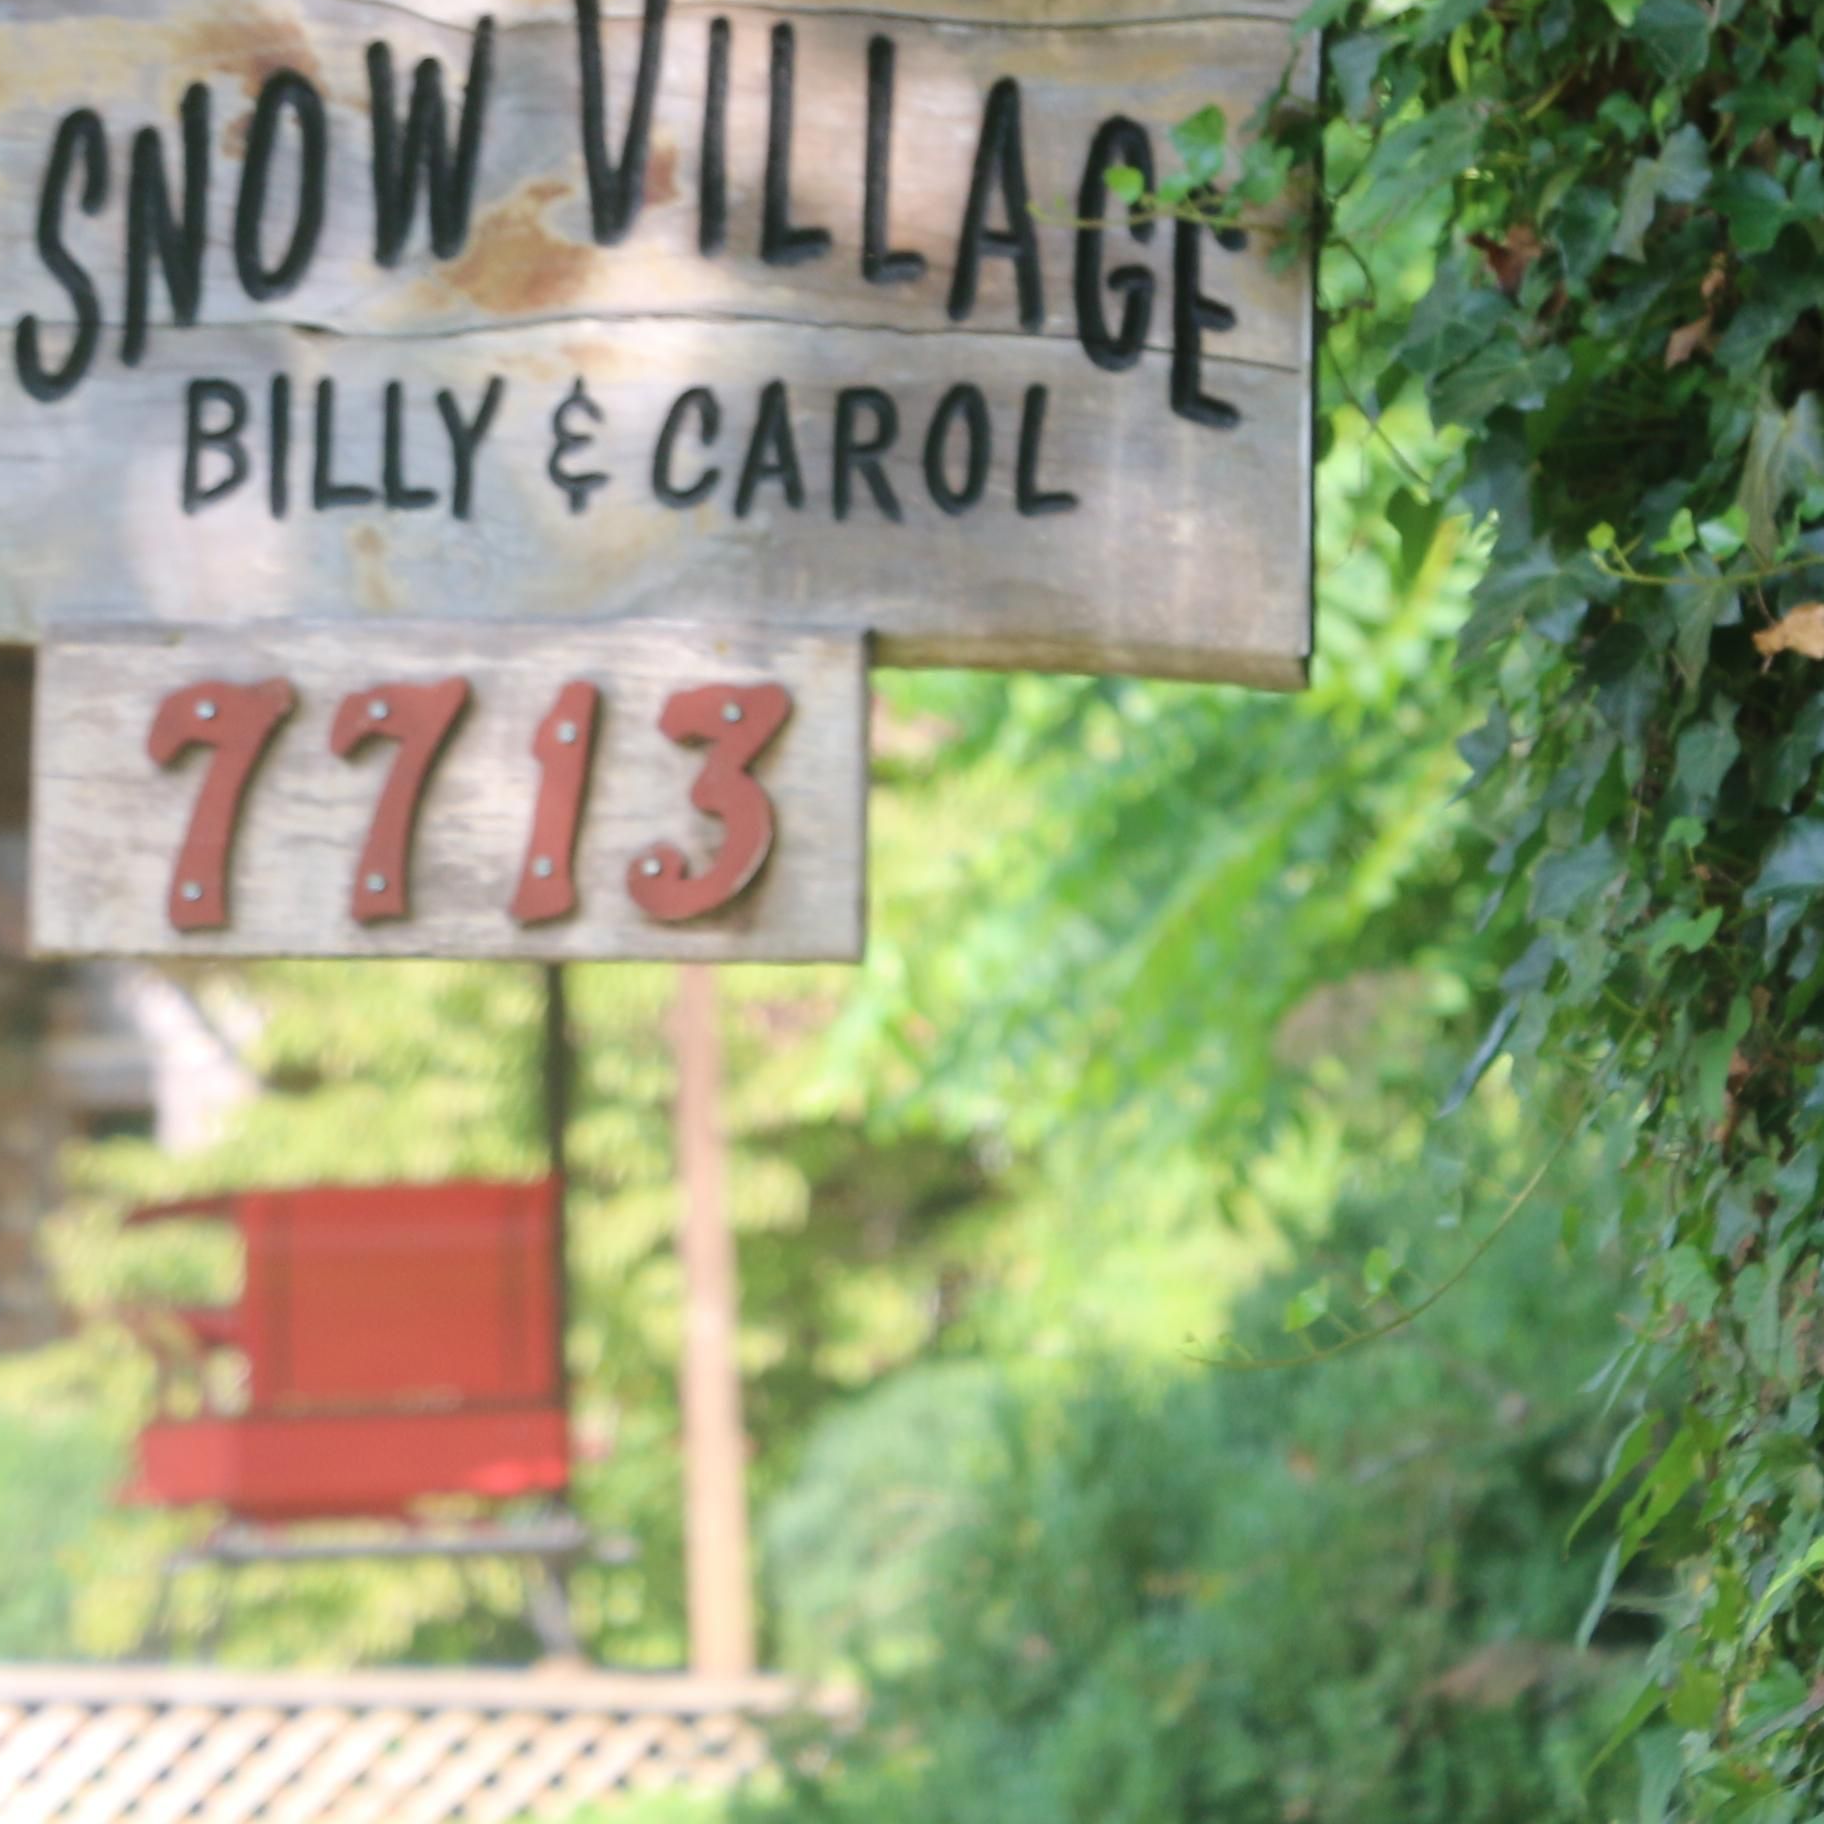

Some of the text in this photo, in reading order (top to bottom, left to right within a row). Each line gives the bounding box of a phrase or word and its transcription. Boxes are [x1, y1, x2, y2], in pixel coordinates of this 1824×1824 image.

[15, 15, 494, 402] SNOW
[182, 375, 1078, 520] BILLY & CAROL
[147, 675, 794, 932] 7713
